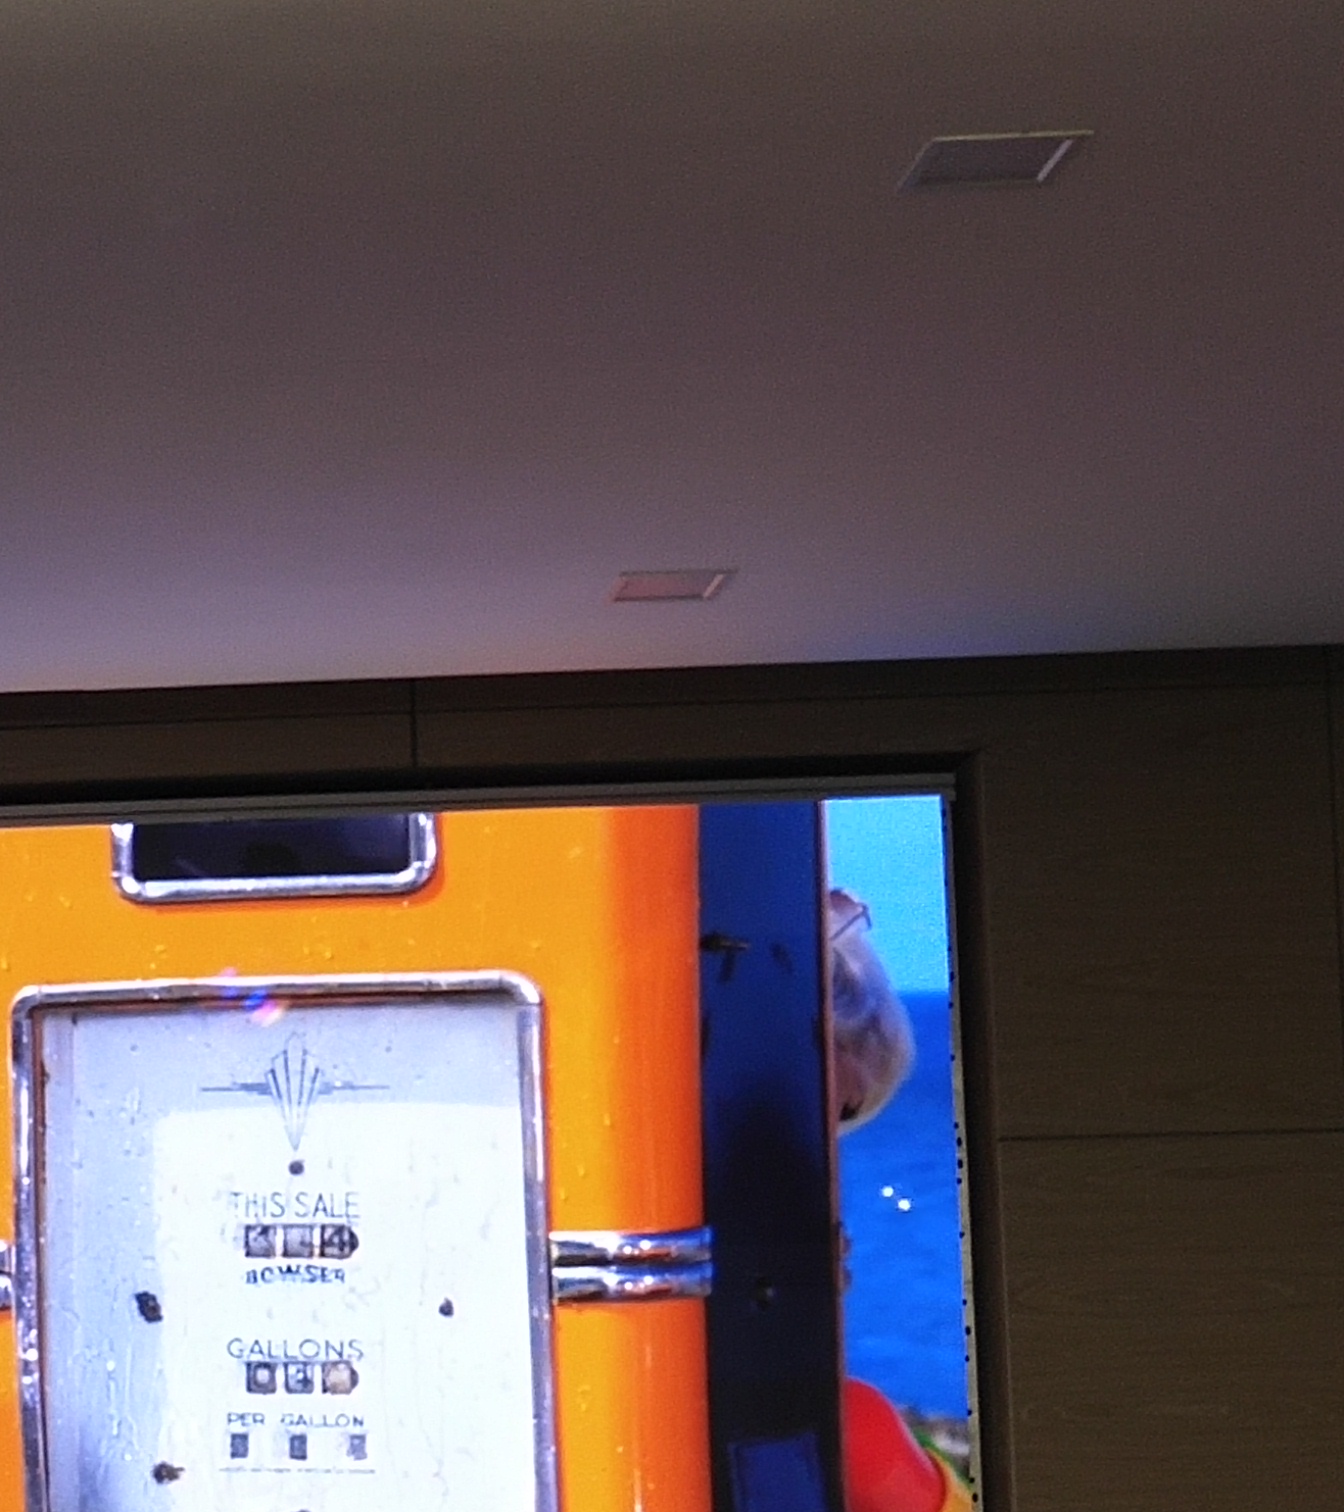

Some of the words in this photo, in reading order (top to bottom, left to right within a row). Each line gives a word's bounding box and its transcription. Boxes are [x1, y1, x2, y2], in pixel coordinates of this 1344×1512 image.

[230, 1191, 286, 1218] THIS
[294, 1191, 361, 1219] SALE
[244, 1264, 346, 1285] BOWSER
[226, 1337, 364, 1361] GALLONS
[226, 1412, 266, 1427] PER
[280, 1412, 365, 1428] GALLON
